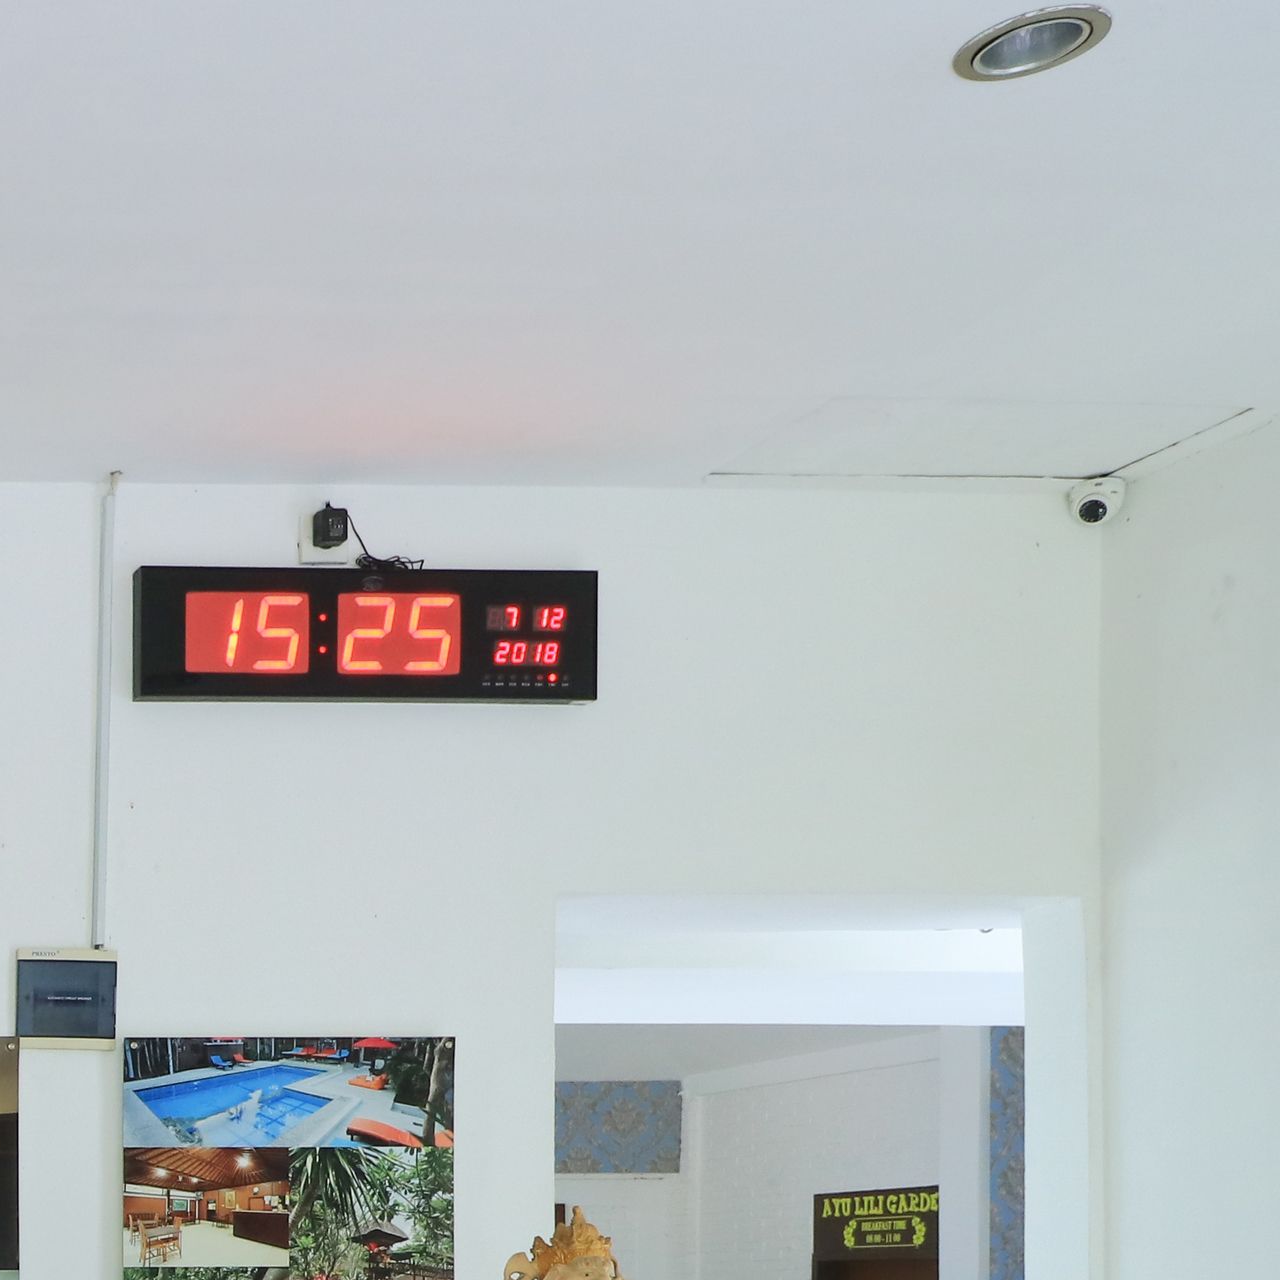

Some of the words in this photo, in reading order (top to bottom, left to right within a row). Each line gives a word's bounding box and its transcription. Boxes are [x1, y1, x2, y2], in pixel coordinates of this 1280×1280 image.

[505, 605, 519, 629] 7
[541, 606, 565, 630] 12
[494, 641, 559, 664] 2018
[822, 1197, 851, 1218] AYU
[854, 1195, 884, 1215] LILI
